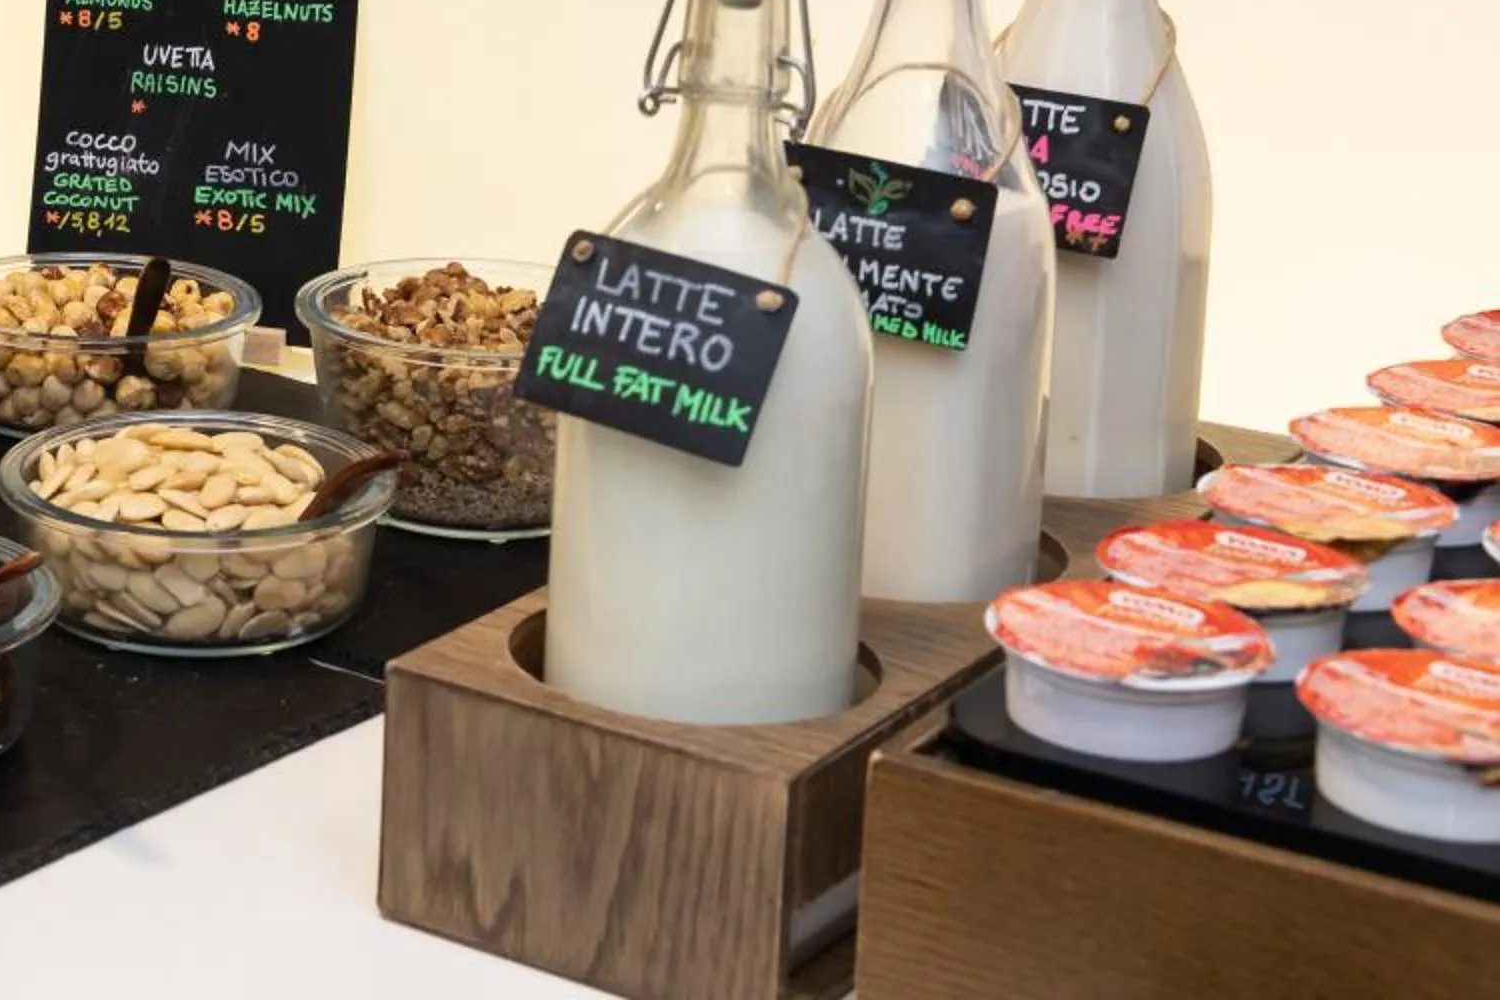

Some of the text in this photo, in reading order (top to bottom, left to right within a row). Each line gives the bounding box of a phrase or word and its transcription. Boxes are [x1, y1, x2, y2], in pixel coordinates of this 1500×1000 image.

[143, 44, 215, 72] UVETTA
[130, 71, 217, 99] RAISINS
[1022, 99, 1087, 135] TTE
[44, 150, 160, 176] grattugiato
[224, 139, 277, 165] MIX
[53, 172, 133, 193] GRATED
[43, 191, 141, 213] COCONUT
[194, 185, 318, 219] EXOTIC MIX
[814, 207, 907, 251] LATTE
[595, 257, 737, 326] LATTE
[858, 257, 964, 301] MENTE
[570, 296, 734, 372] INTERO
[869, 314, 967, 350] MED MILK
[535, 345, 753, 433] FULL FAT MILK
